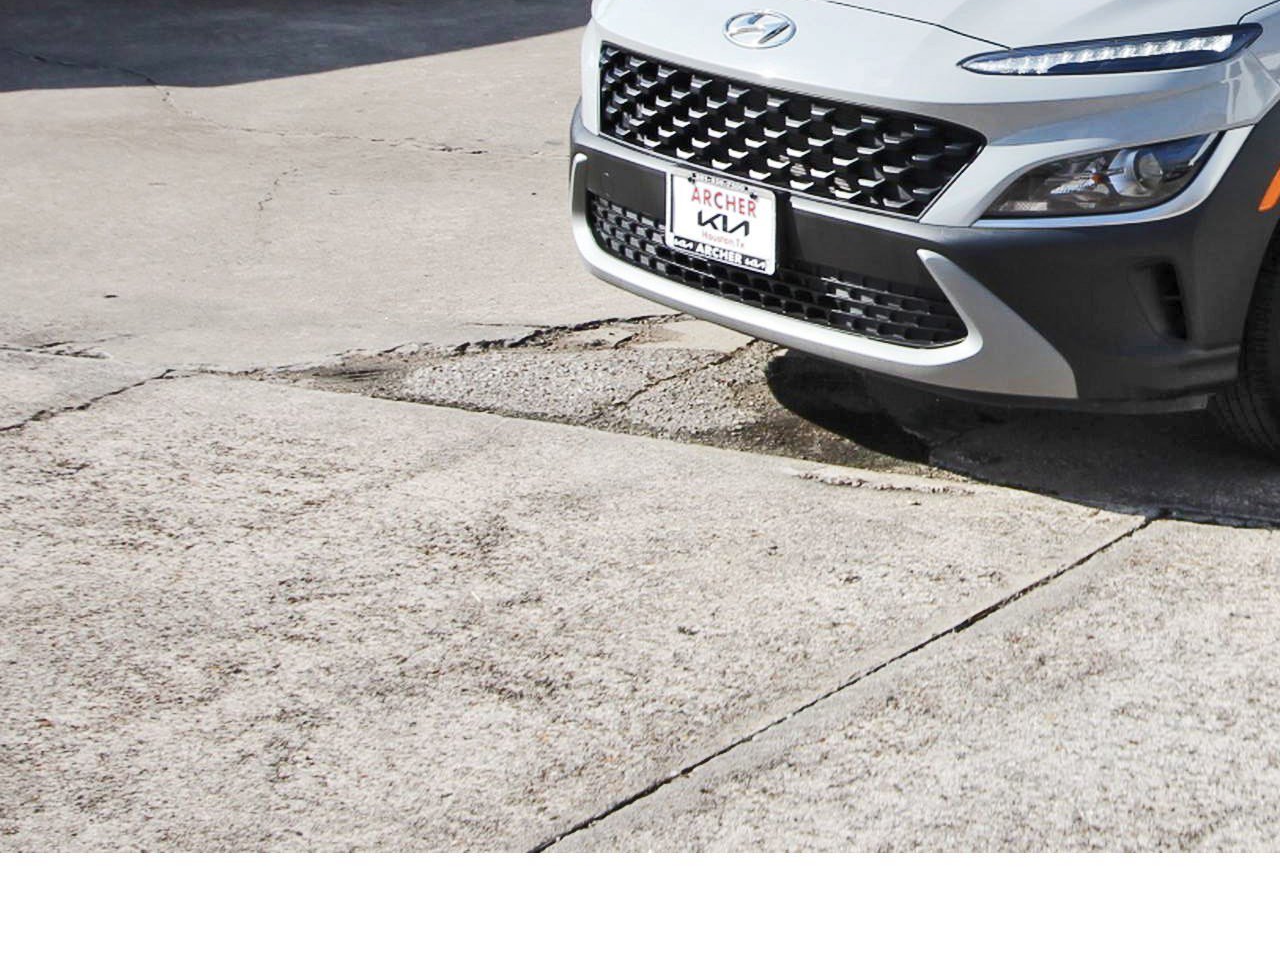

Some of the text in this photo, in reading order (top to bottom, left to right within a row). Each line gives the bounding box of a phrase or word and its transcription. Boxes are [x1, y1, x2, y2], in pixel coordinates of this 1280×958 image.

[691, 187, 757, 218] ARCHER
[697, 210, 750, 237] KIA
[696, 243, 743, 265] ARCHER
